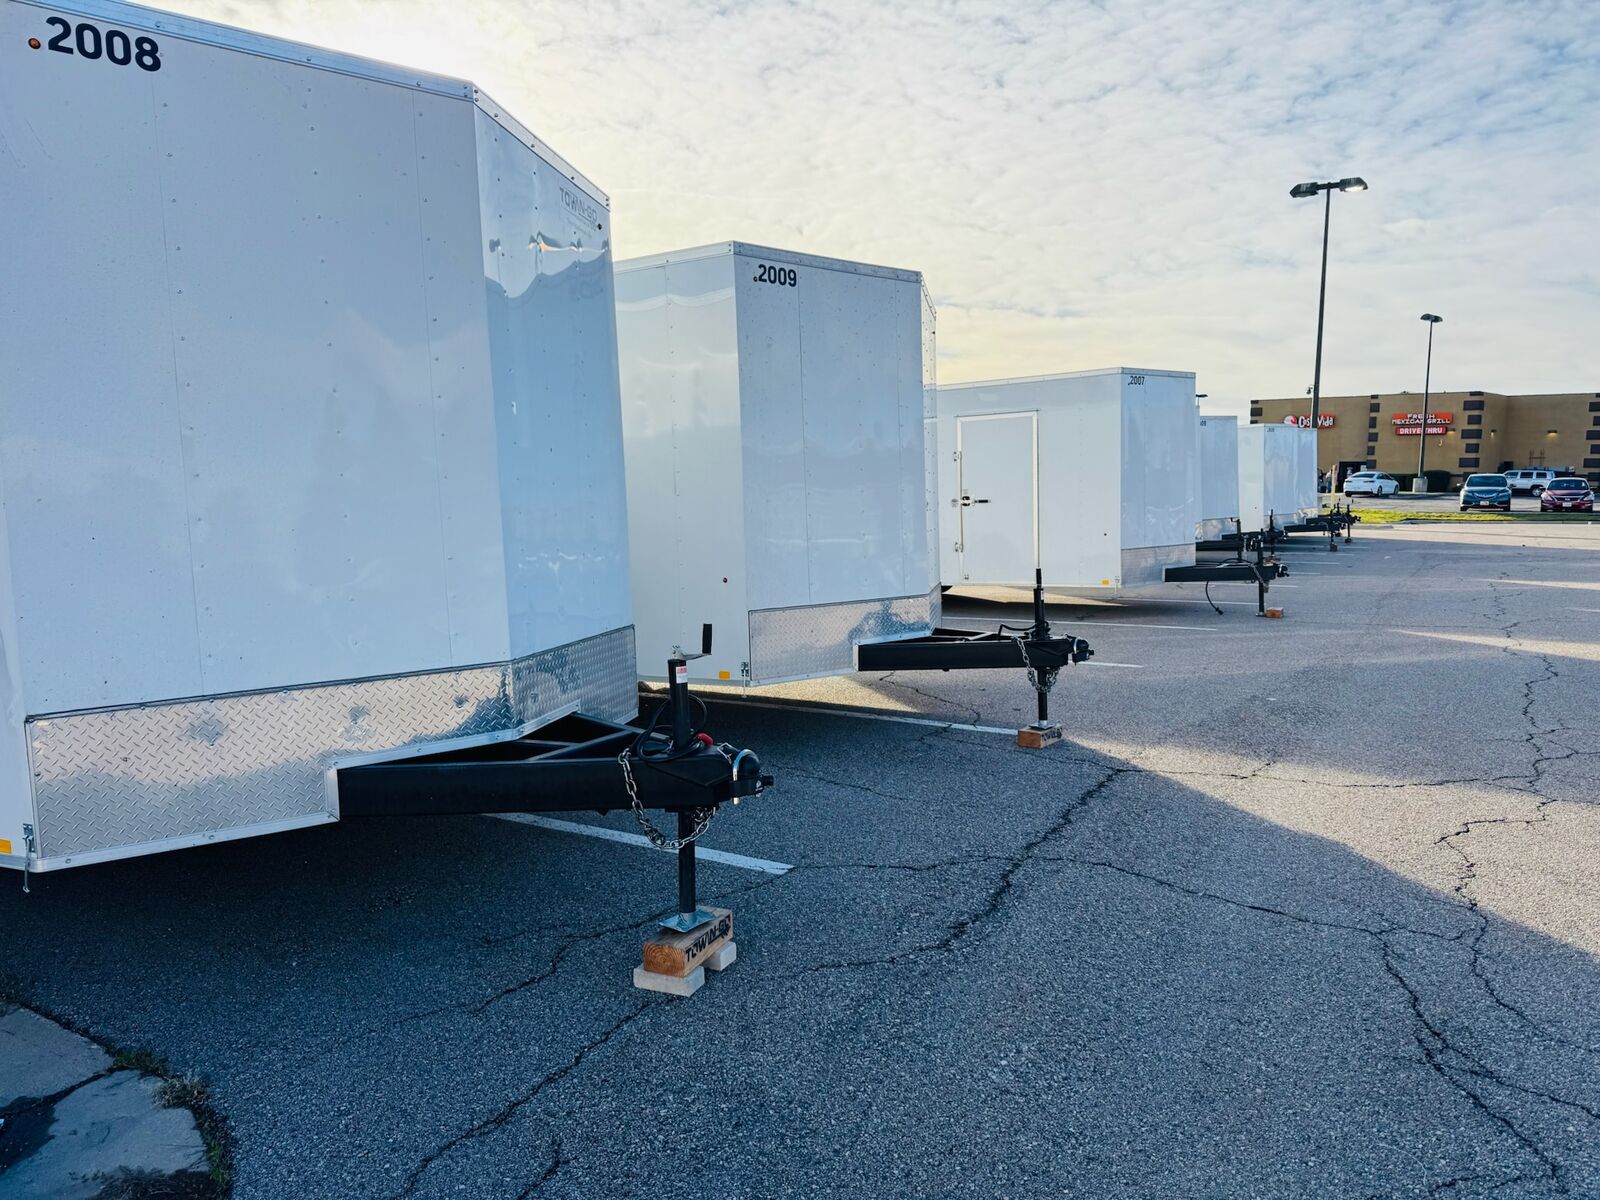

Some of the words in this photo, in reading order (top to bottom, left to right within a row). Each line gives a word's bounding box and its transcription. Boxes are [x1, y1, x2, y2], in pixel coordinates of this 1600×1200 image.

[46, 16, 161, 72] 2008
[758, 264, 797, 287] 2009
[1129, 375, 1145, 386] 2007
